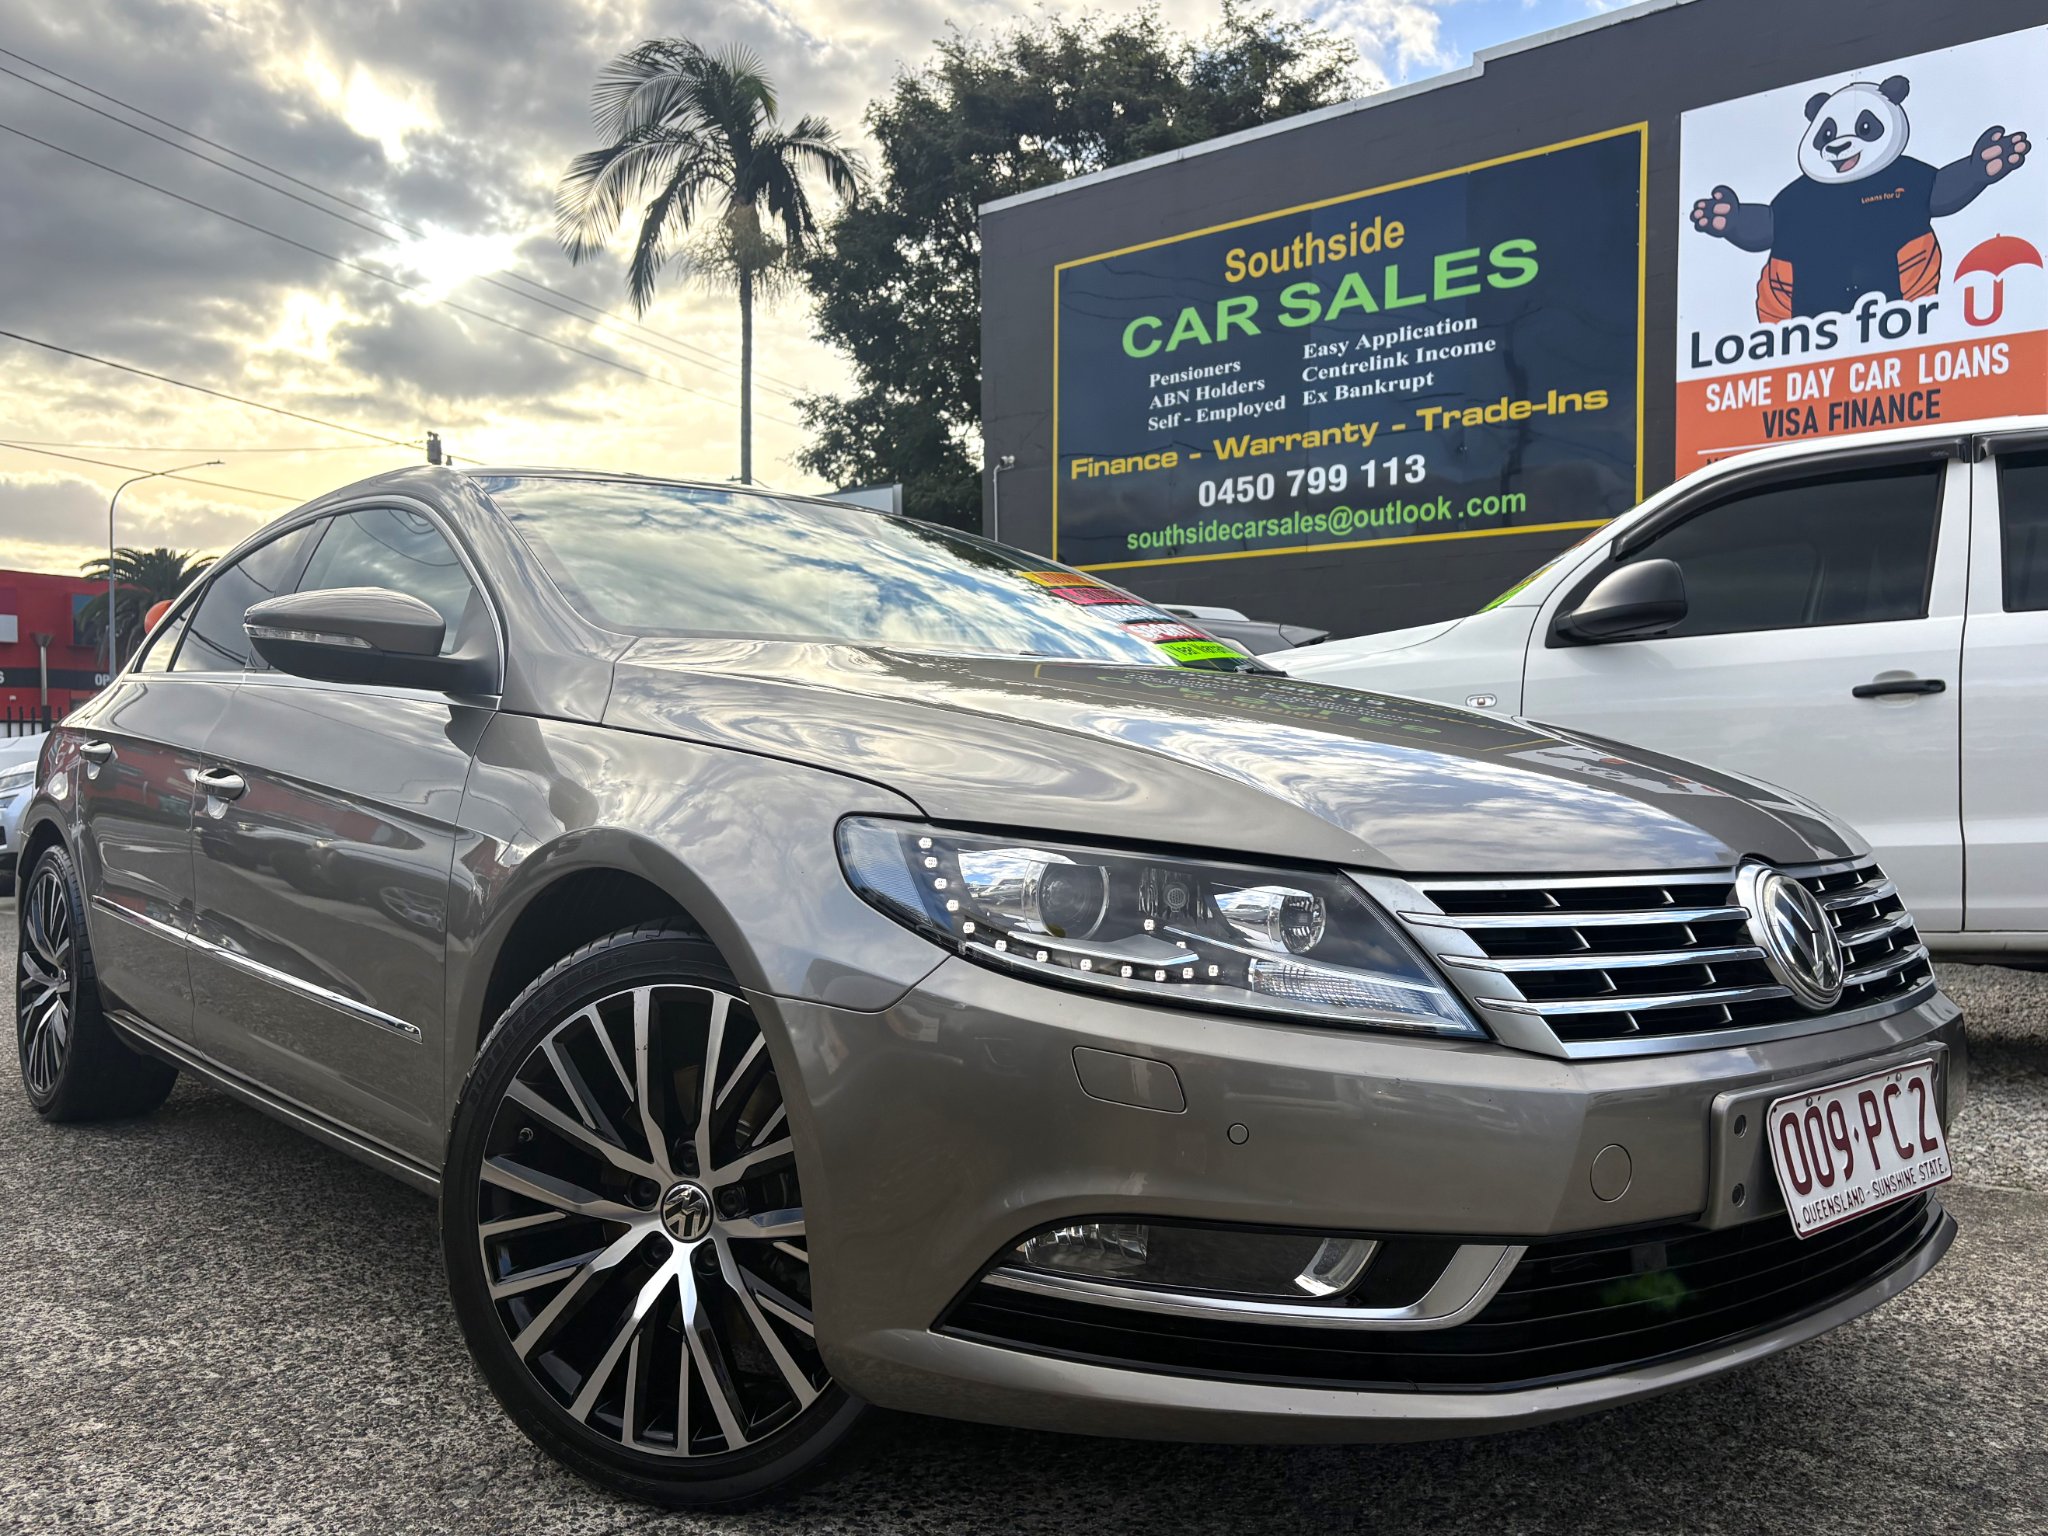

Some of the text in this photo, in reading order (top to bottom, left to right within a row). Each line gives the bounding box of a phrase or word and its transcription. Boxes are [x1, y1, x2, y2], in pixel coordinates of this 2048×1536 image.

[1224, 216, 1405, 284] Southside
[1121, 238, 1540, 358] CAR SALES
[1301, 336, 1497, 384] Centrelink Income
[1303, 314, 1479, 362] Easy Application
[1690, 317, 1839, 369] Loans
[1855, 298, 1940, 344] for
[1149, 357, 1242, 389] Pensioners
[1149, 376, 1266, 411] ABN Holders
[1301, 371, 1435, 408] Ex Bankrupt
[1705, 342, 2009, 413] SAME DAY CAR LOANS
[1070, 451, 1178, 480] Finance
[1213, 422, 1380, 463] Warranty
[1416, 388, 1609, 435] Trade-Ins
[1147, 412, 1180, 433] Self
[1196, 395, 1287, 429] Employed
[1762, 388, 1941, 439] VISA FINANCE
[1198, 453, 1427, 508] 0450 799 113
[1802, 1187, 1866, 1226] QUEENSLAND
[1871, 1171, 1916, 1200] SUNSHINE
[1918, 1157, 1945, 1183] STATE
